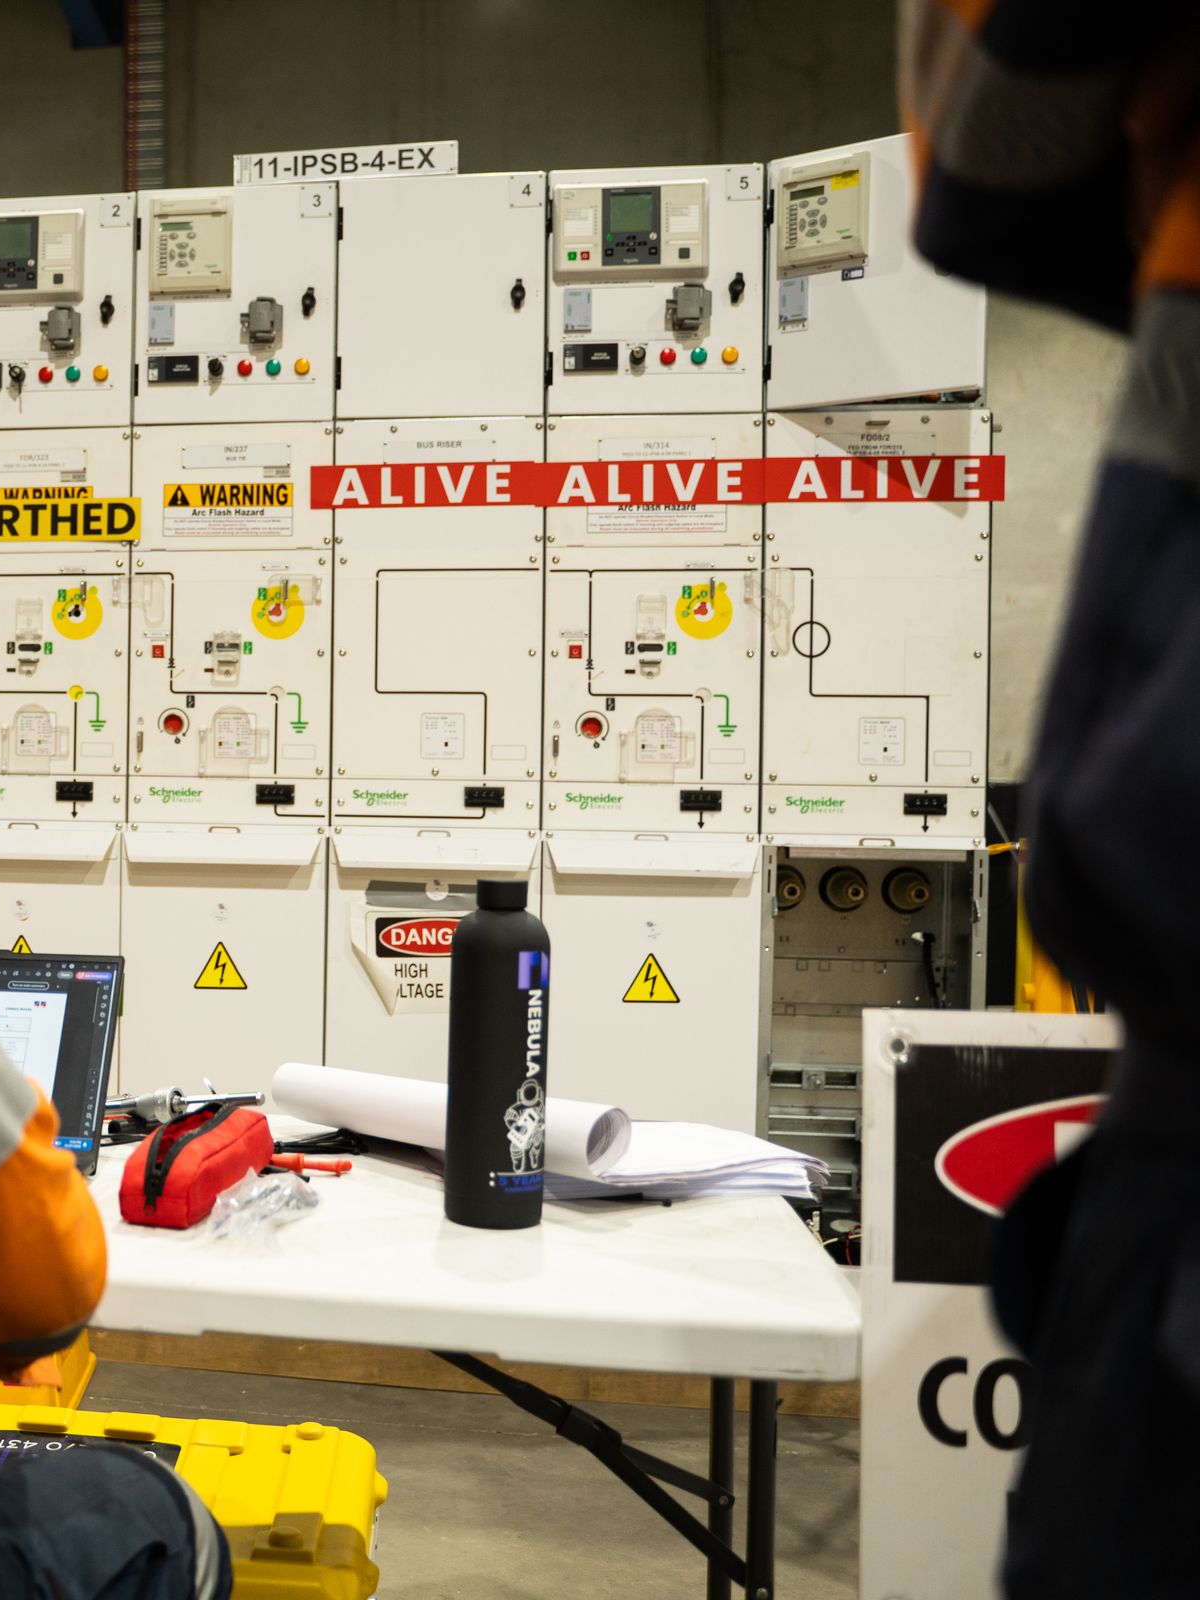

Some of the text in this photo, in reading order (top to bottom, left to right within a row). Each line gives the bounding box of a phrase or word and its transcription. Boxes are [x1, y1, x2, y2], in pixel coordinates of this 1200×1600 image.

[253, 147, 436, 180] 11-IPSB-4-EX
[522, 183, 532, 197] 4
[739, 176, 750, 190] 5
[312, 194, 322, 208] 3
[112, 204, 120, 217] 2
[416, 440, 463, 449] BUS RISER
[331, 464, 512, 506] ALIVE
[557, 461, 744, 504] ALIVE
[787, 458, 981, 500] ALIVE
[199, 483, 289, 506] WARNING
[191, 508, 266, 517] Arc Flash Hazard
[664, 503, 697, 512] Hazard
[148, 786, 204, 801] Schneider
[352, 789, 409, 804] Schneider
[565, 792, 625, 807] Schneider
[784, 795, 847, 811] Schneider
[390, 927, 457, 946] DANG
[394, 963, 428, 979] HIGH
[396, 983, 444, 999] LTAGE
[525, 988, 544, 1079] NEBULA
[512, 1174, 544, 1186] YEAR
[917, 1355, 1033, 1451] CO
